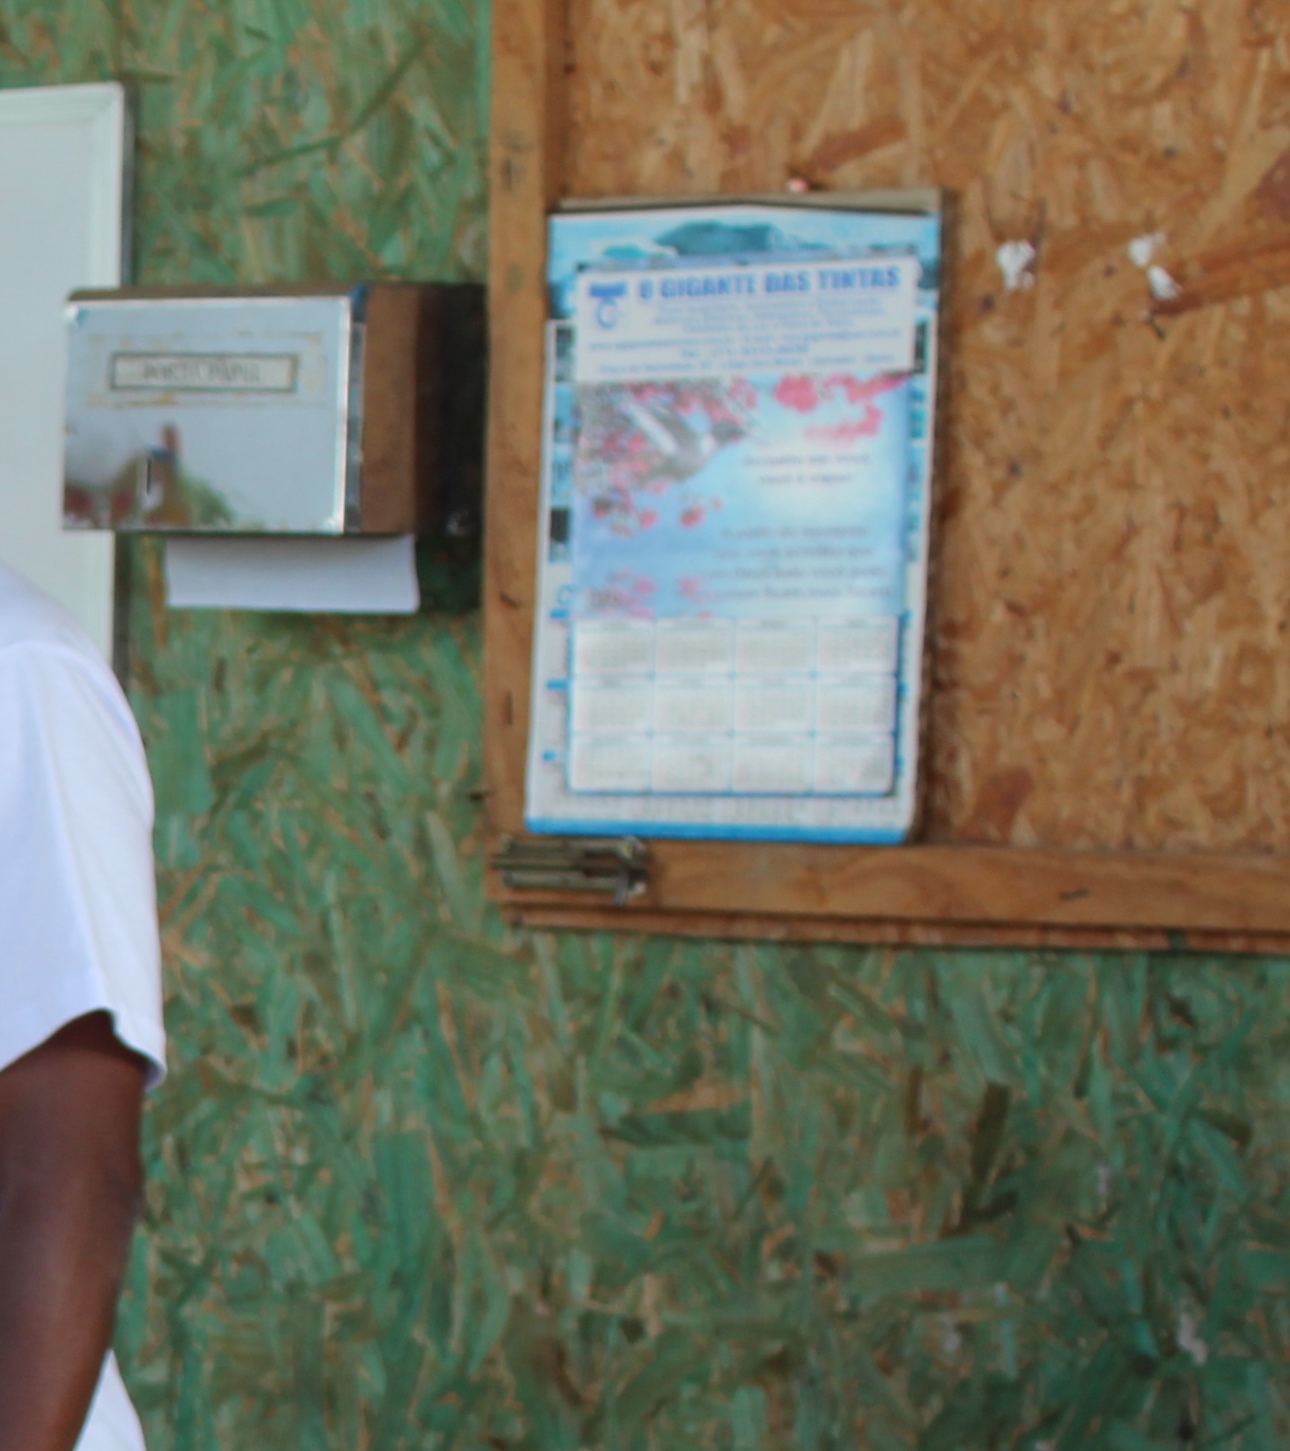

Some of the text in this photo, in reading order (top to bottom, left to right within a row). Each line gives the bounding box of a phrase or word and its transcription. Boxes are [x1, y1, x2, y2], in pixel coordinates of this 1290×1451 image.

[638, 266, 900, 300] O GIGANTE DAS TINTAS
